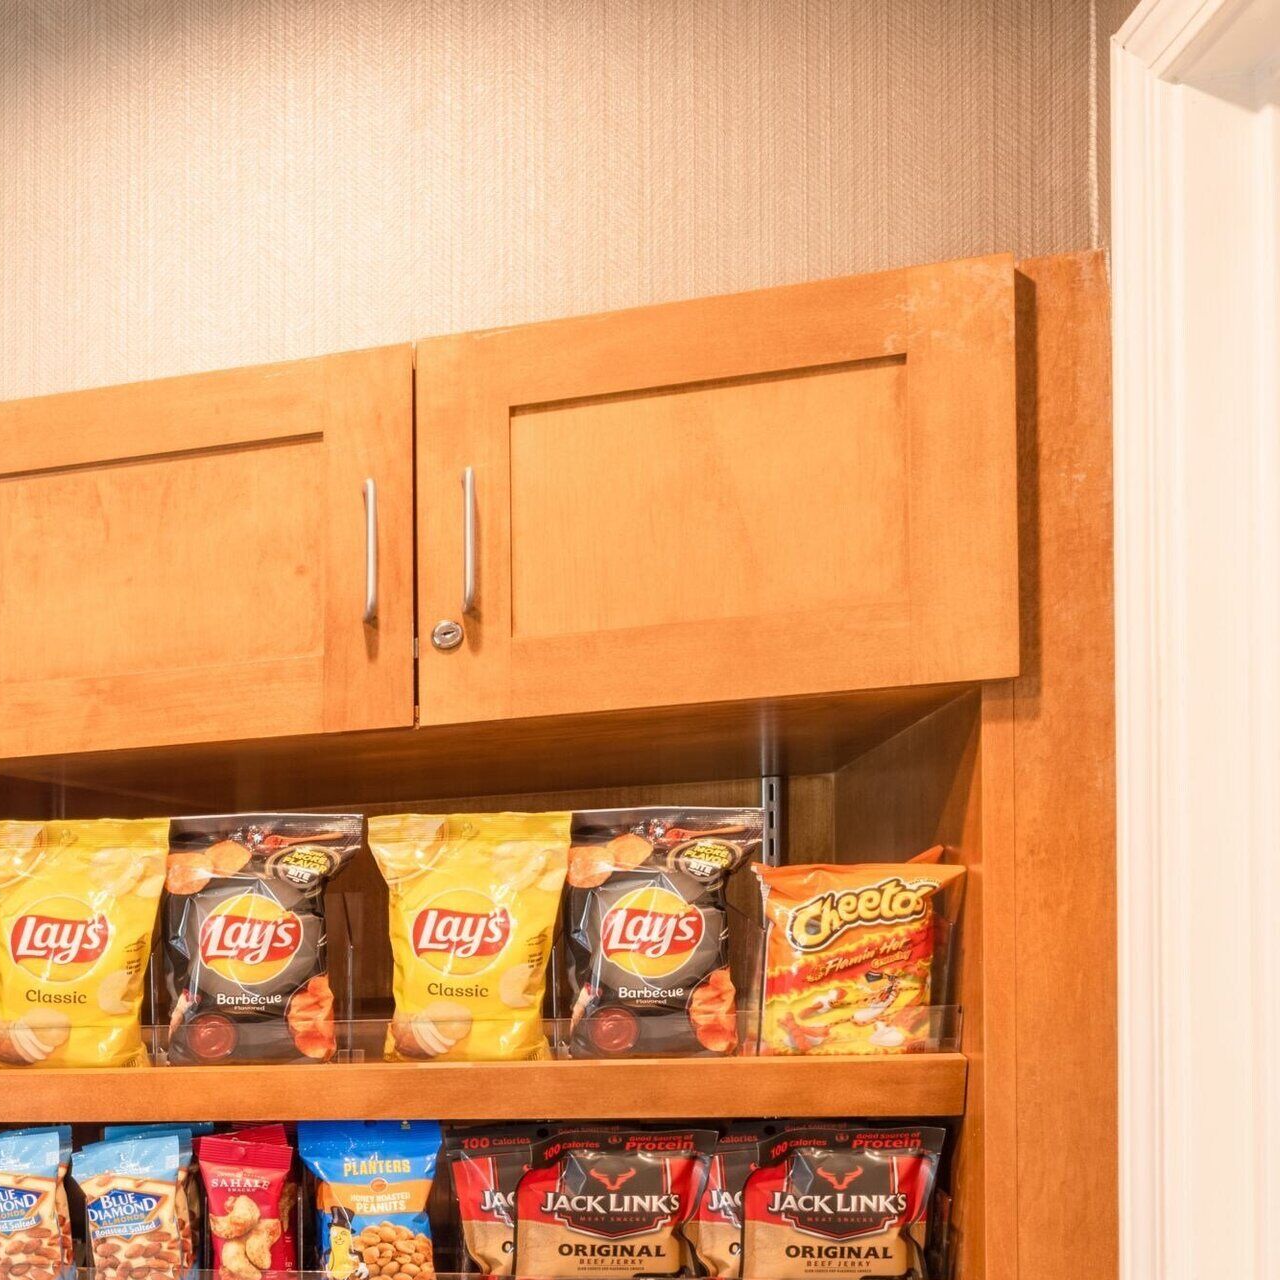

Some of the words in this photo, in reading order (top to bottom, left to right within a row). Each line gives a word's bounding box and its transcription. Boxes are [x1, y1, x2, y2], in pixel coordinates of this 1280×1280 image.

[792, 880, 935, 947] Cheetos
[16, 913, 107, 965] Lay's
[205, 914, 295, 964] Lay's
[25, 989, 87, 1005] Classic
[216, 993, 282, 1006] Barbecue
[461, 1137, 489, 1149] 100
[625, 1140, 694, 1151] Protein
[343, 1159, 411, 1177] PLANTERS
[211, 1177, 270, 1190] SAHALE
[88, 1198, 157, 1222] DIAMOND
[356, 1200, 406, 1213] PEANUTS
[541, 1193, 606, 1213] JACK
[609, 1193, 680, 1213] LINK'S
[769, 1193, 833, 1213] JACK
[836, 1192, 907, 1213] LINK'S
[9, 1219, 36, 1231] Salted
[558, 1243, 666, 1258] ORIGINAL
[785, 1244, 893, 1259] ORIGINAL
